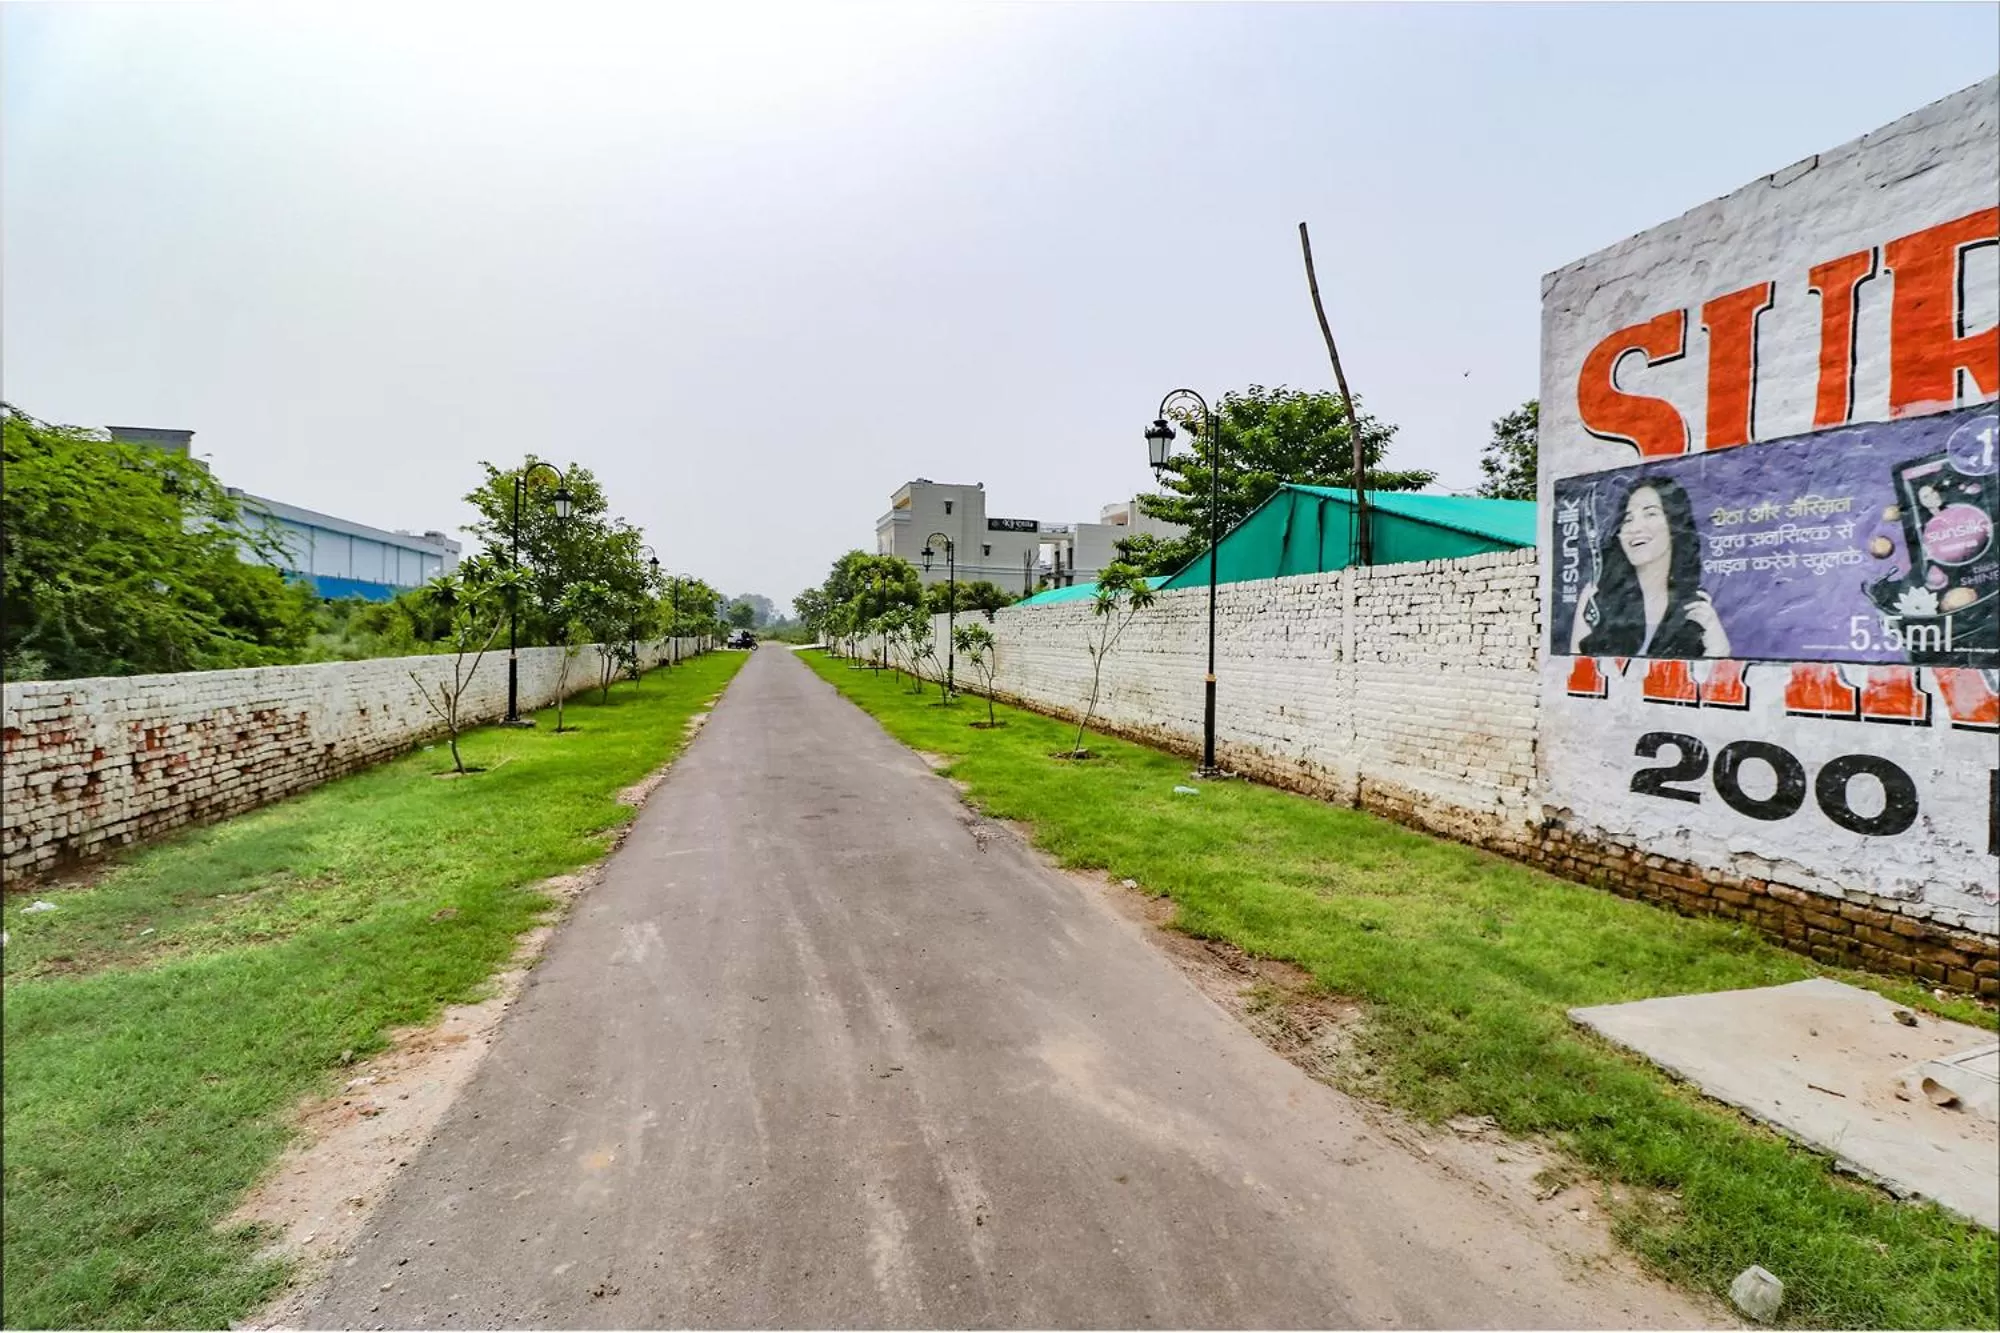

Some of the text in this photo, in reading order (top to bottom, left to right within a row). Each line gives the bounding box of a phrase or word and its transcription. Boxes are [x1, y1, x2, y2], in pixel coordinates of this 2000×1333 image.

[1748, 500, 1782, 523] और
[1834, 519, 1856, 540] से
[1558, 497, 1580, 583] sunsilk
[1849, 615, 1953, 653] 5.5ml
[1630, 731, 1919, 837] 200
